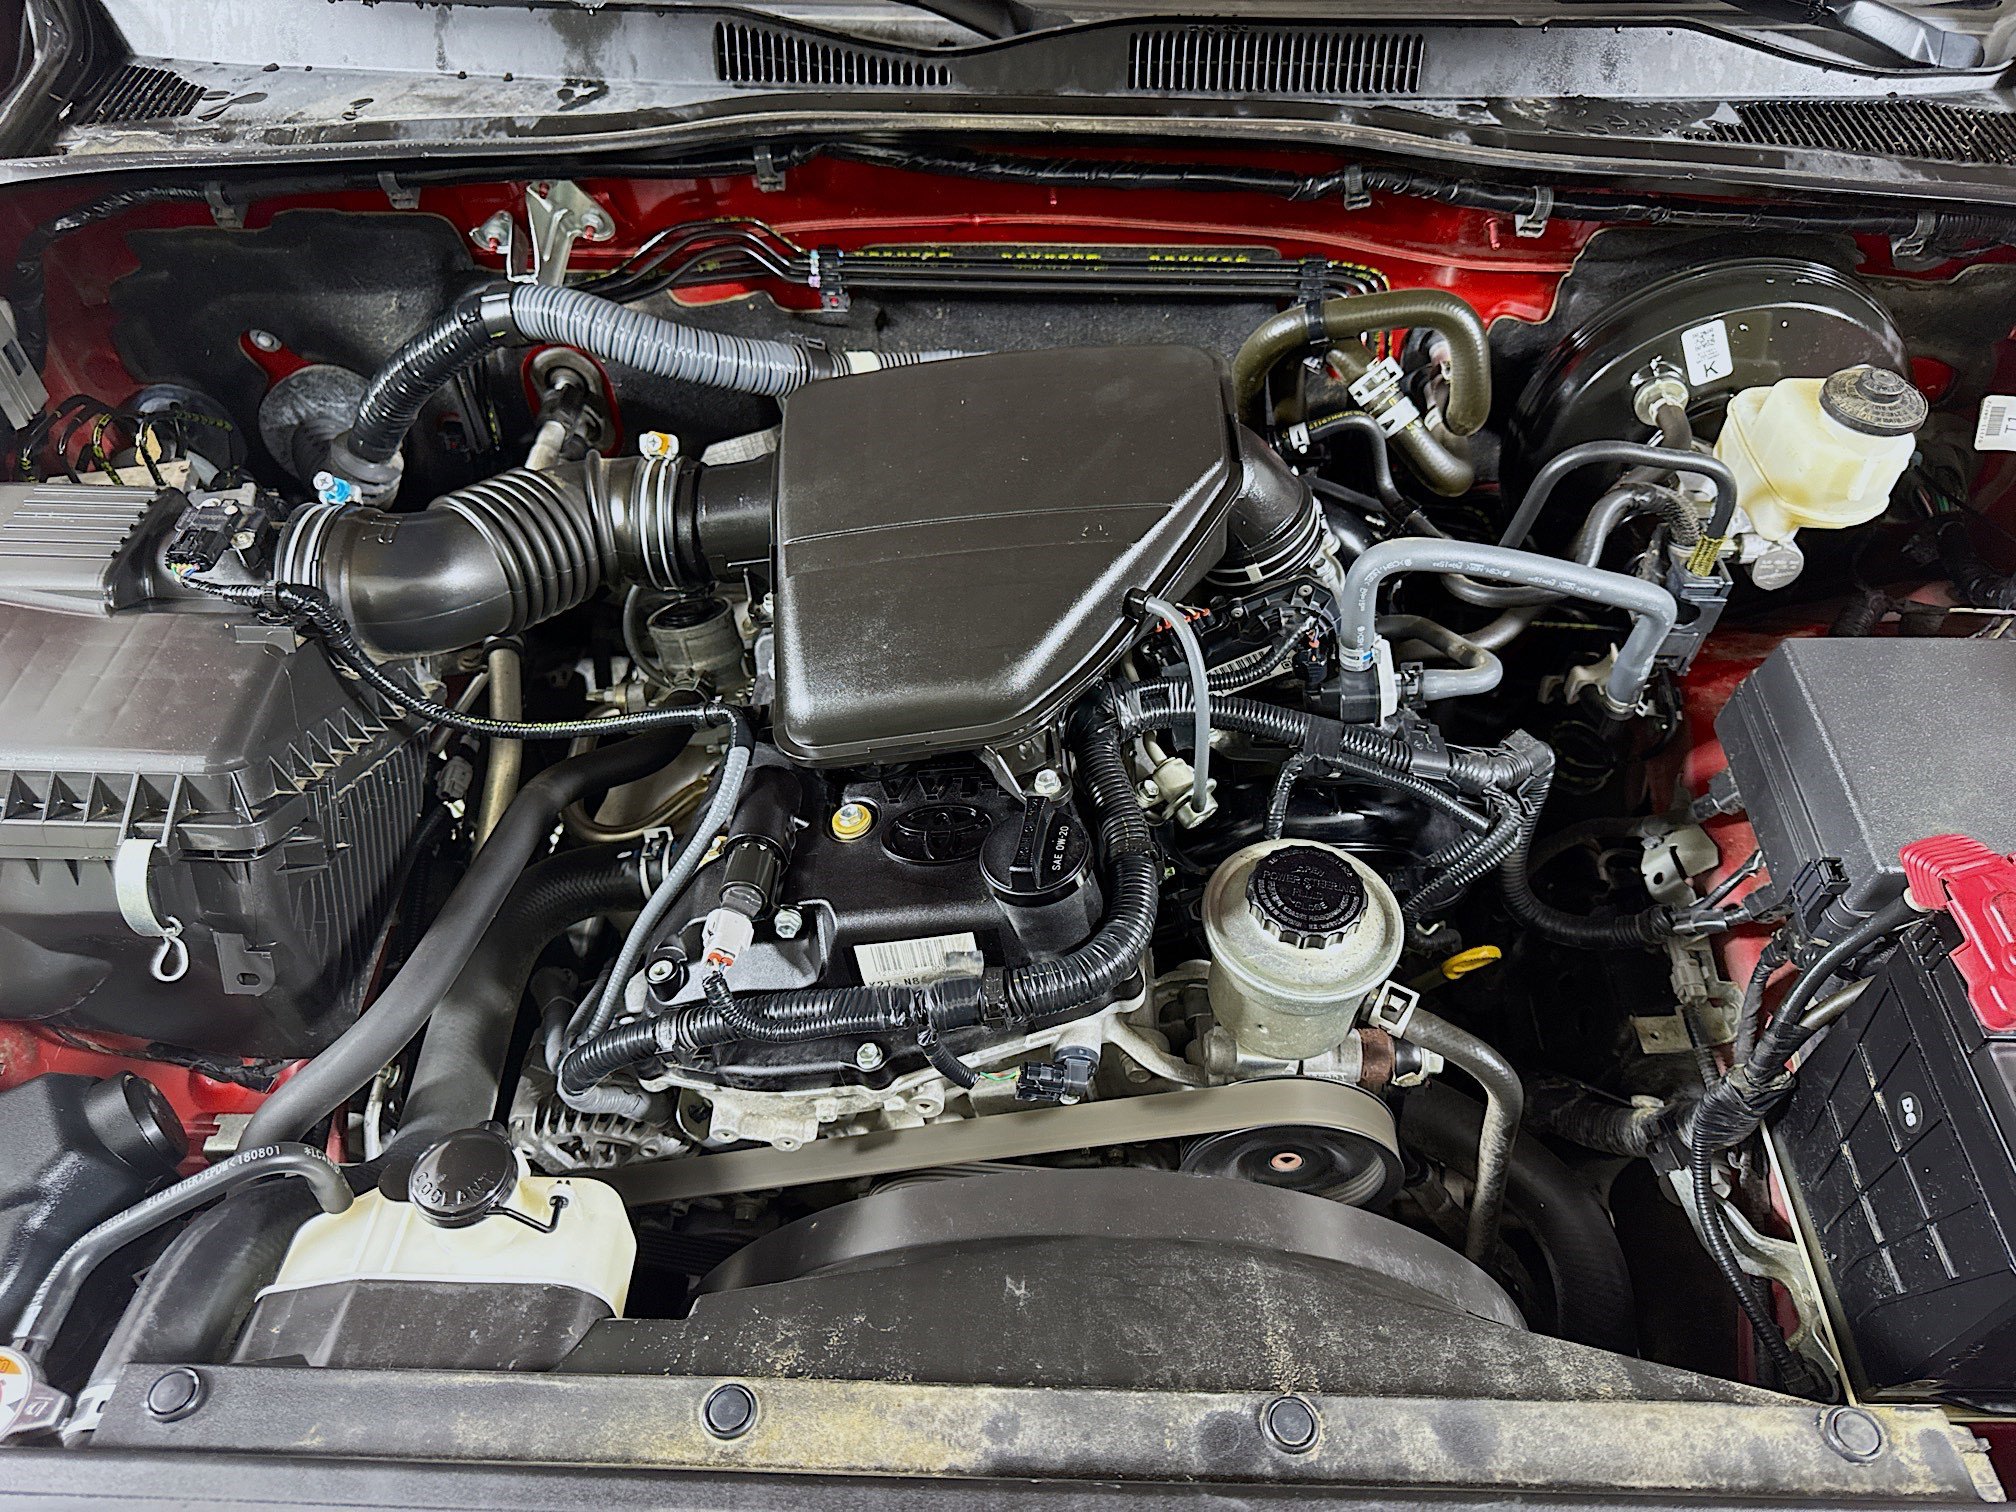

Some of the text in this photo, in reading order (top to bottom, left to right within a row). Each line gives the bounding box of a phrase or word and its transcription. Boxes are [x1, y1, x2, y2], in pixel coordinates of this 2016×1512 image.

[1704, 361, 1718, 378] K
[1052, 853, 1063, 871] SAE
[1262, 870, 1357, 895] POWER STEERING
[414, 1171, 495, 1207] COOLANT
